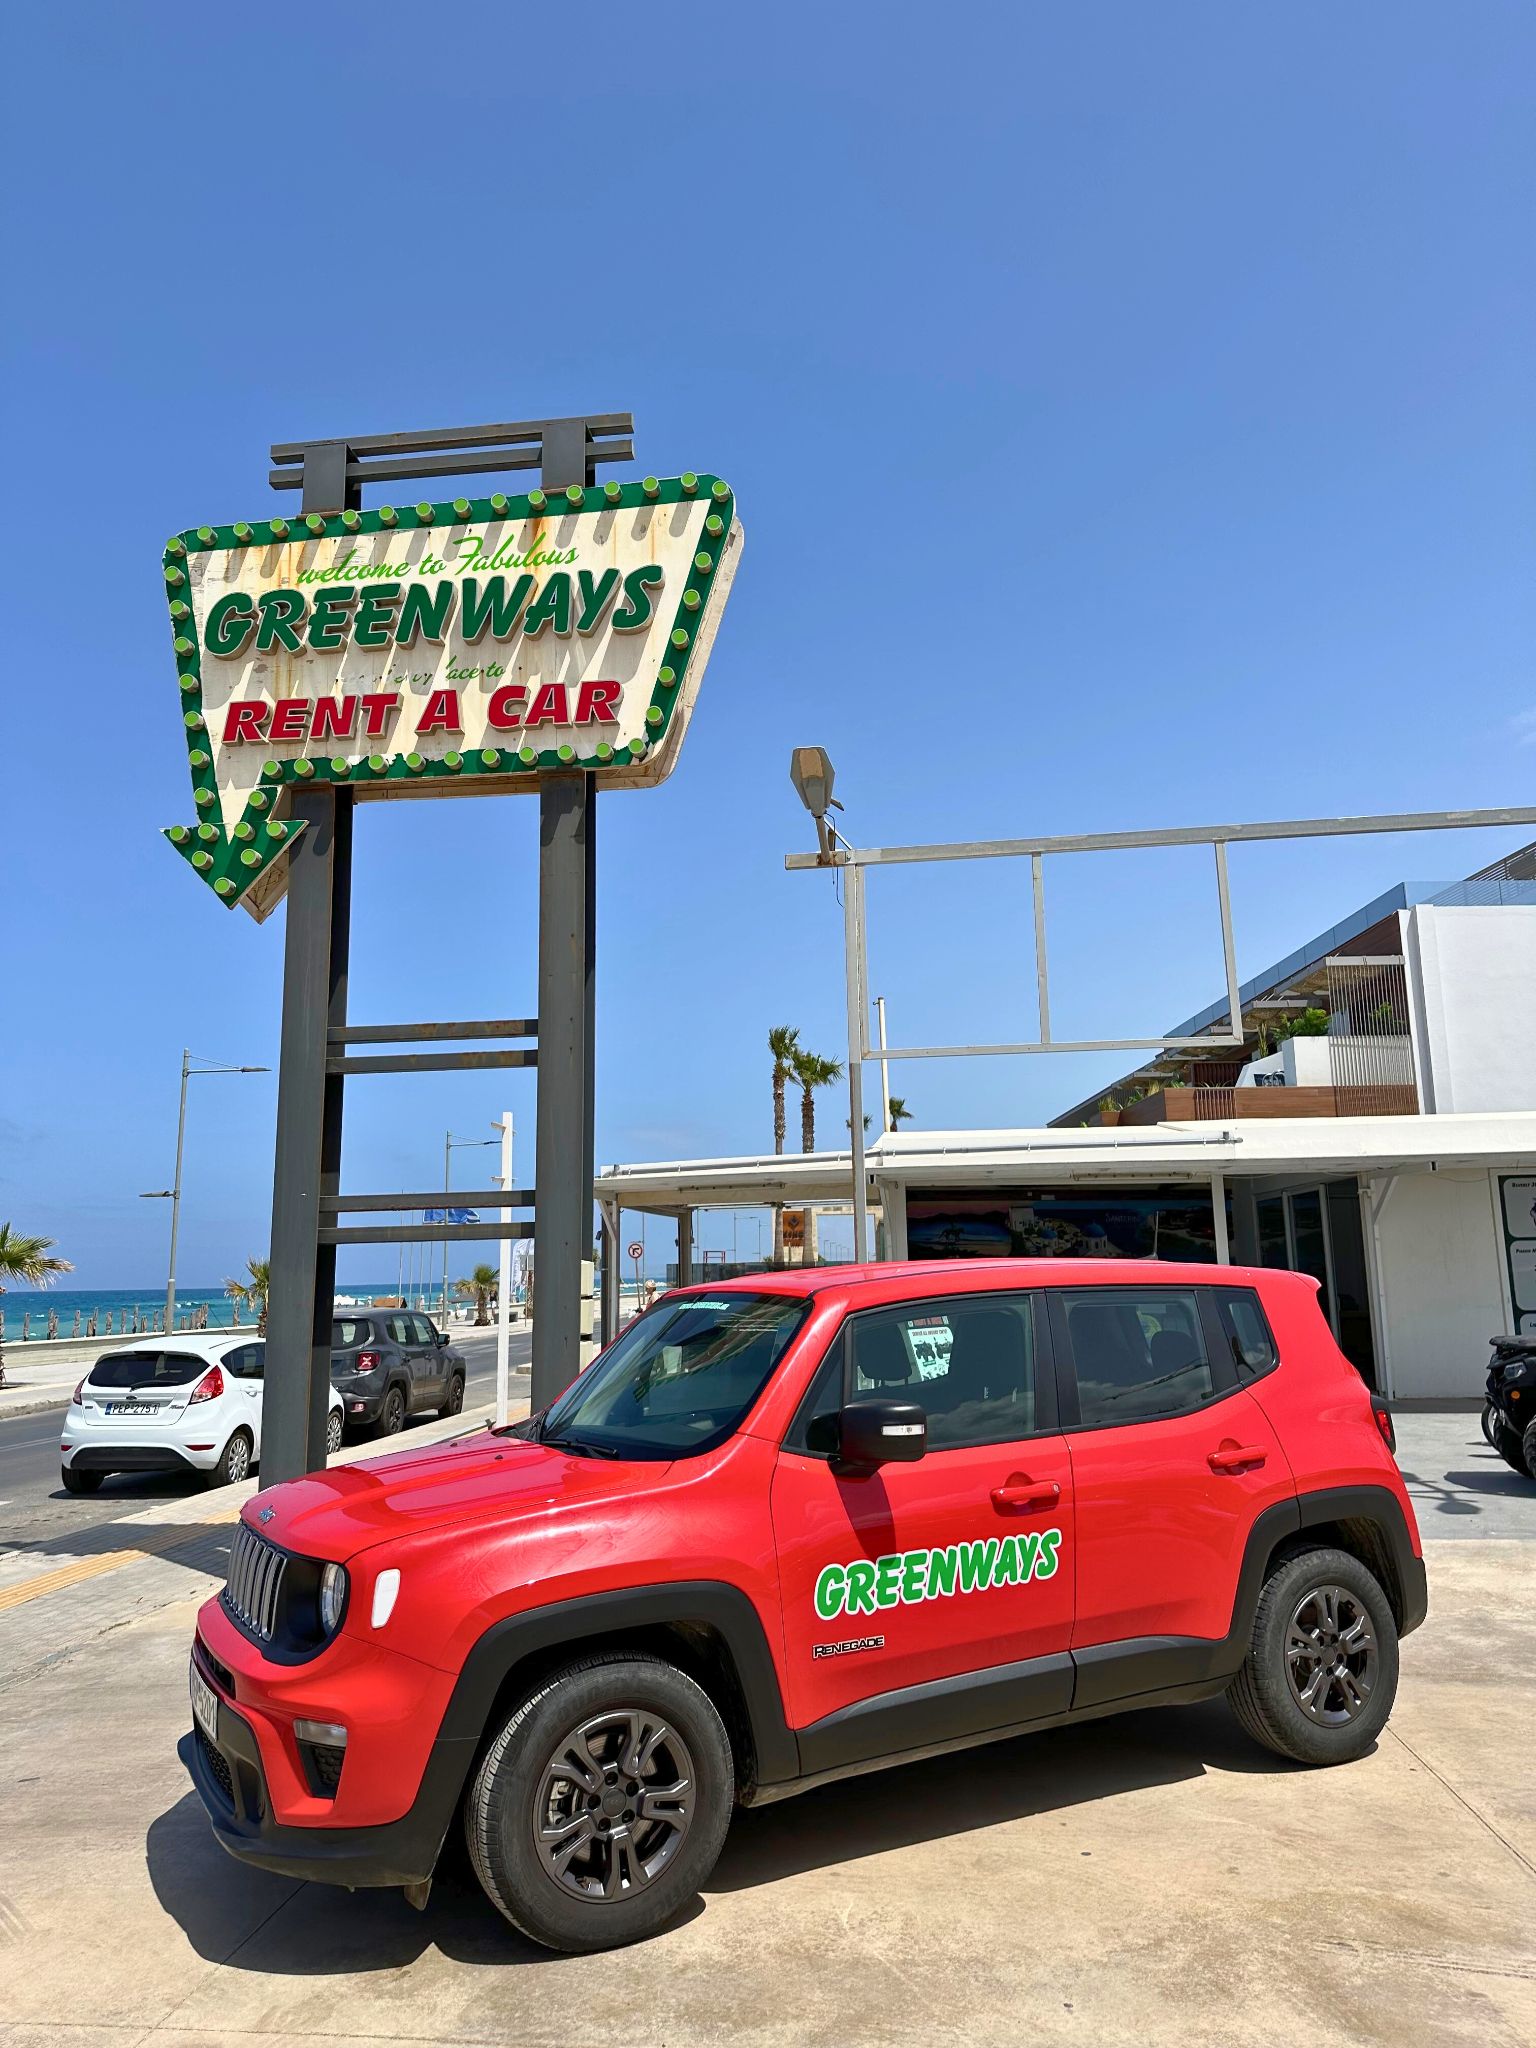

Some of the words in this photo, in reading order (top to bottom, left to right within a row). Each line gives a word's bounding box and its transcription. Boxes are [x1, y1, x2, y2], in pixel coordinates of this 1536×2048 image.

[297, 548, 411, 585] welcome
[418, 552, 447, 576] to
[452, 531, 580, 576] Fabulous
[205, 564, 664, 659] GREENWAYS
[486, 660, 506, 679] to
[222, 692, 402, 744] RENT
[415, 688, 463, 737] A
[487, 680, 623, 730] CAR
[814, 1529, 1062, 1620] GREENWAYS
[813, 1636, 884, 1658] RENEGADE
